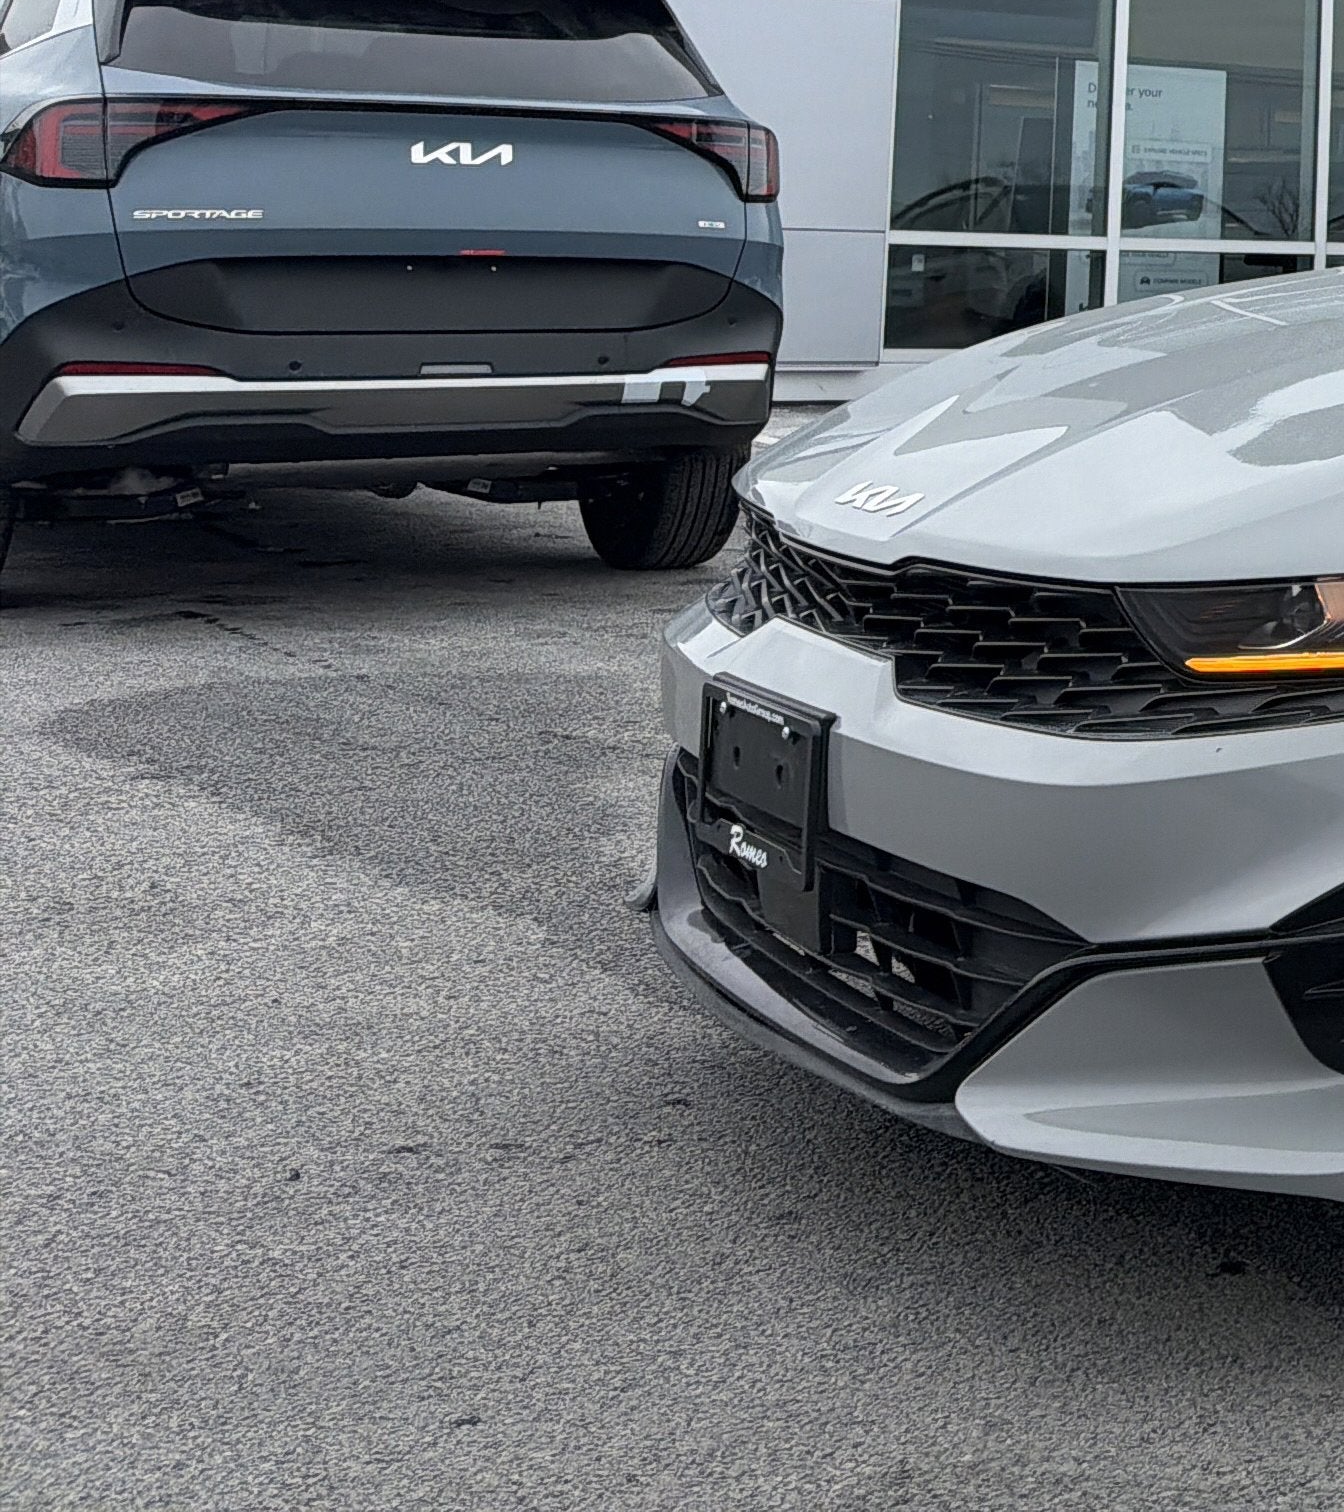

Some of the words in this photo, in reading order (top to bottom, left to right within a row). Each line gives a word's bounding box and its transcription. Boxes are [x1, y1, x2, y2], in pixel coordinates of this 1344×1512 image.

[1138, 88, 1163, 99] your
[410, 140, 513, 166] KIA
[132, 209, 264, 219] SPORTAGE
[834, 480, 925, 517] KIA
[728, 824, 769, 869] Romeo
